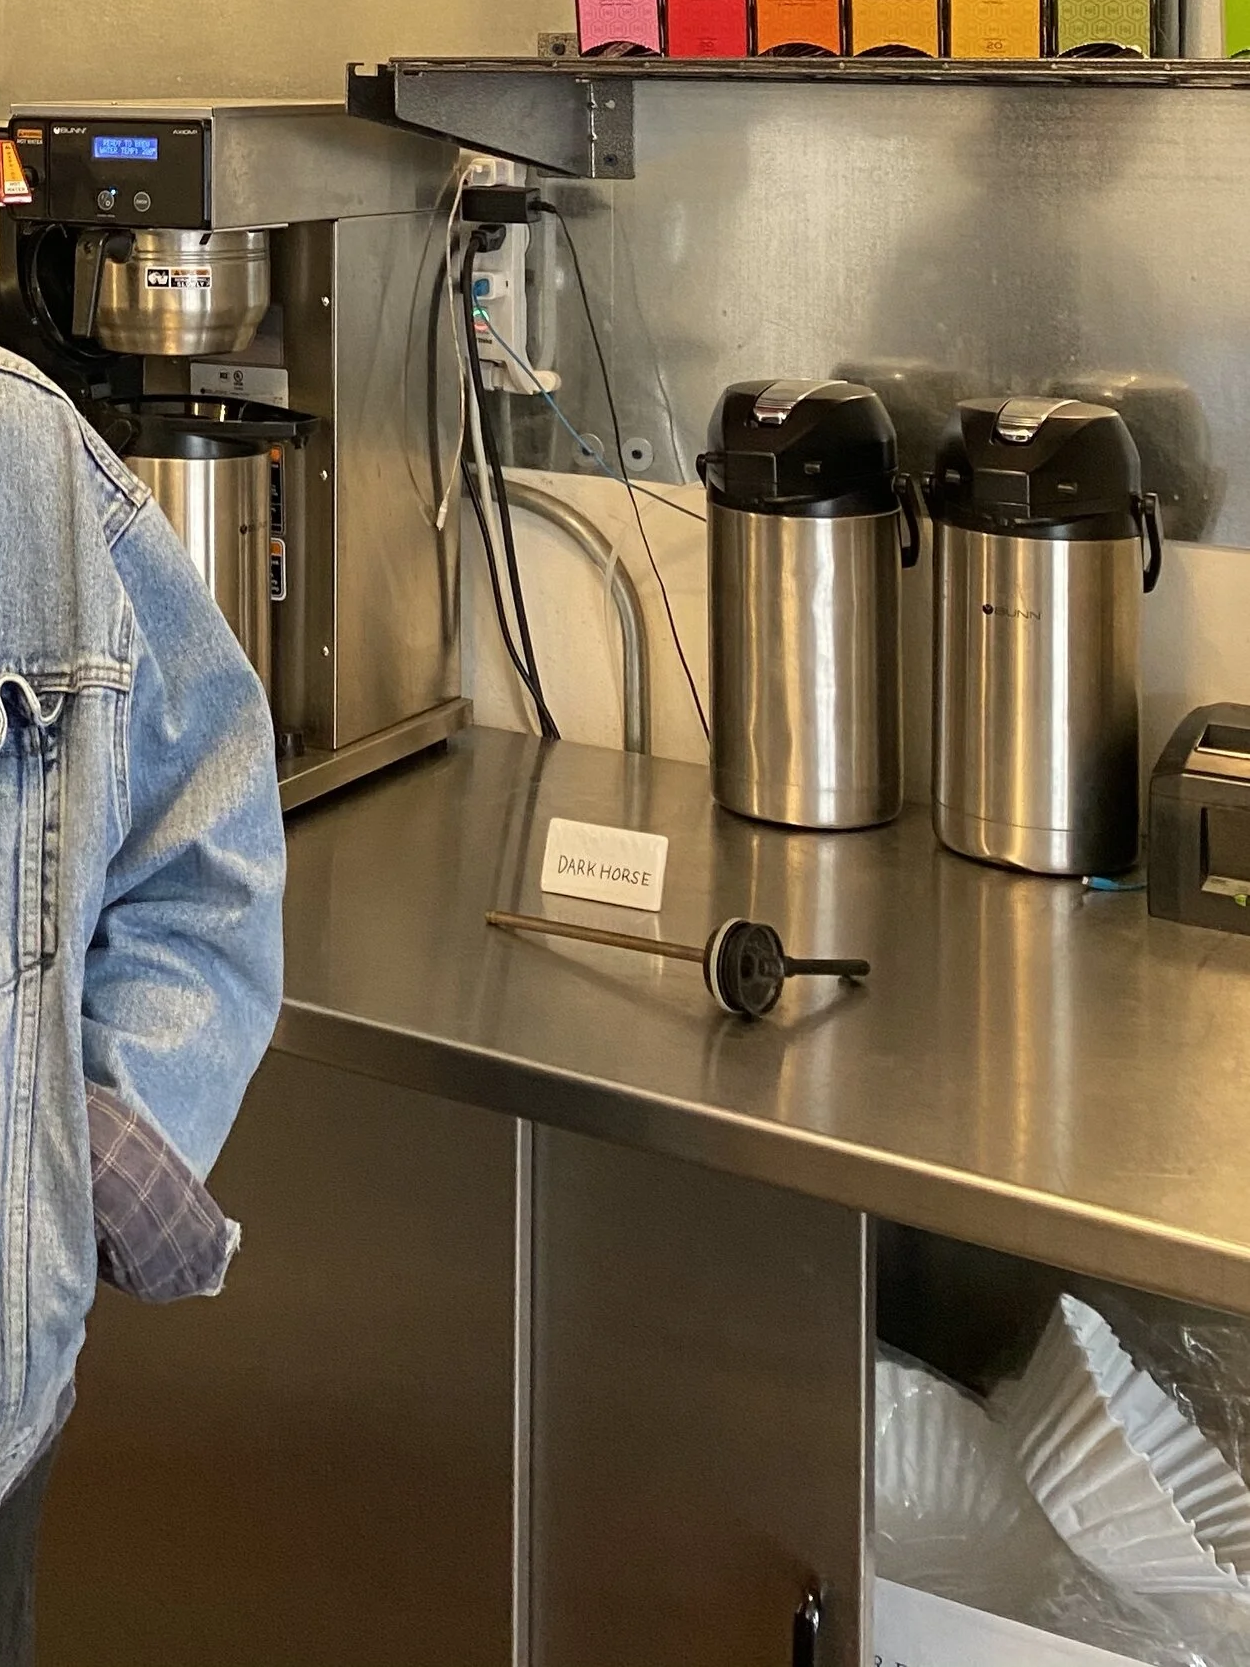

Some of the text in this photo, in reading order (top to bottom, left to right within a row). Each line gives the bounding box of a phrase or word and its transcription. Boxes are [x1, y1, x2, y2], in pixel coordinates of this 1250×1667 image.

[985, 41, 1003, 50] 20
[994, 606, 1041, 621] BUNN
[557, 854, 653, 887] DARK HORSE
